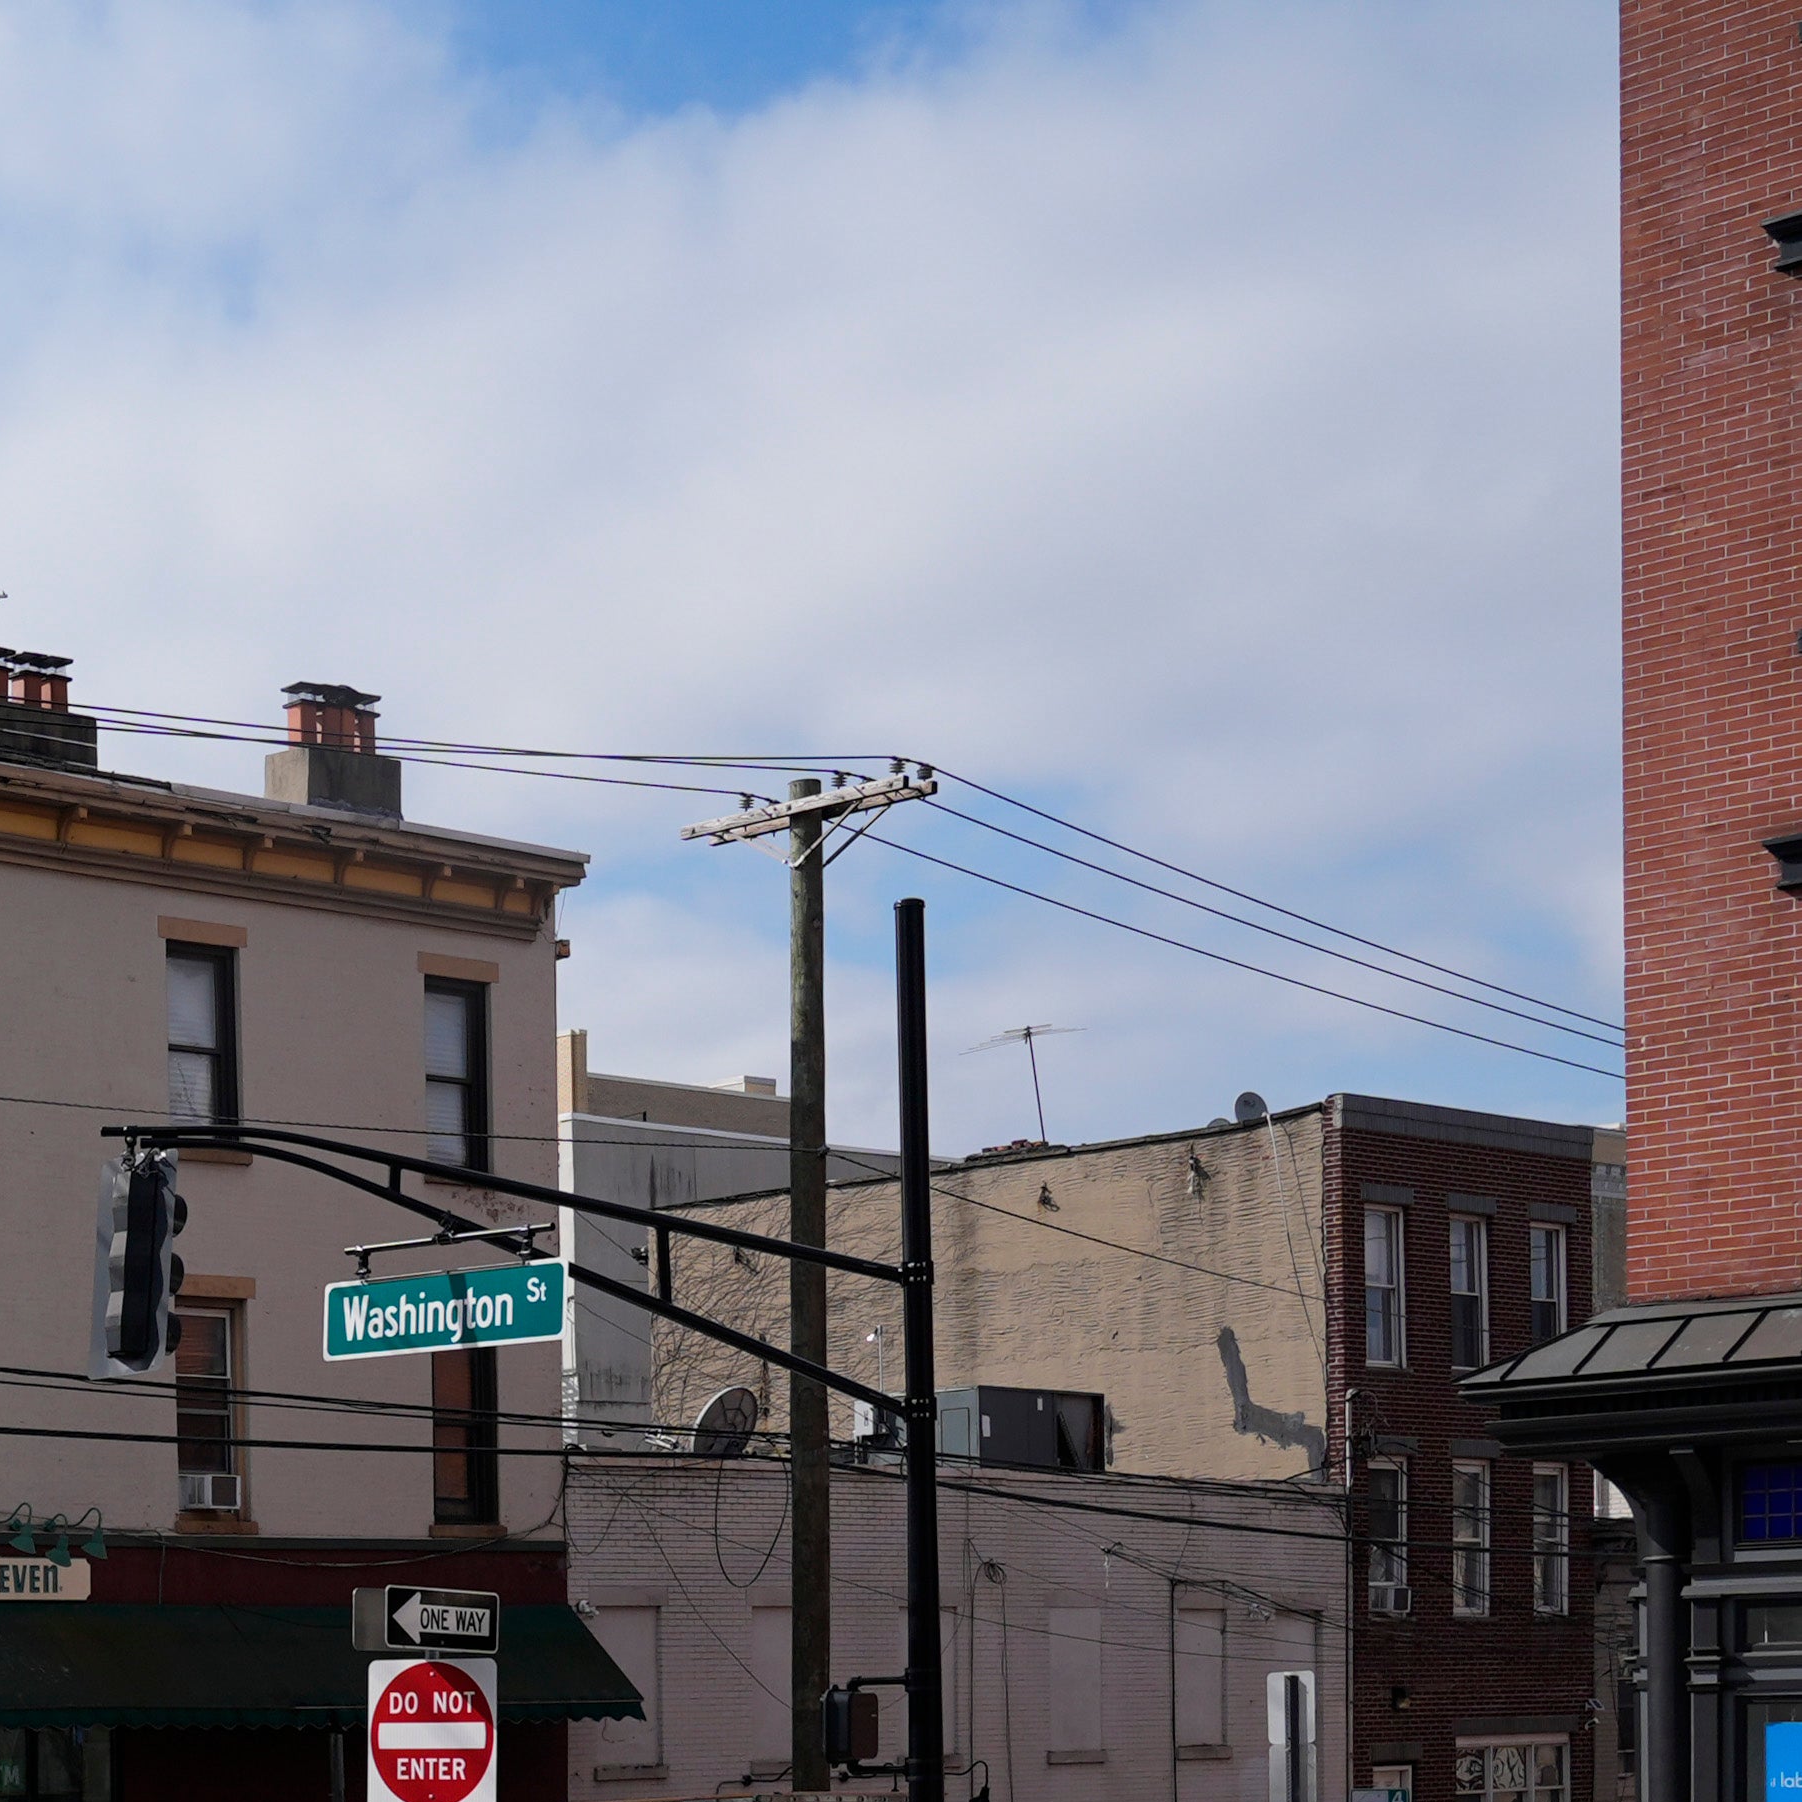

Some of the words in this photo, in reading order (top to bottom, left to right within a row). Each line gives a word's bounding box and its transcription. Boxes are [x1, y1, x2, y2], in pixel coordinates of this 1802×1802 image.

[343, 1286, 513, 1343] Washington
[526, 1277, 547, 1303] St
[419, 1607, 450, 1632] ONE
[455, 1610, 486, 1634] WAY
[389, 1692, 419, 1715] DO
[432, 1691, 476, 1714] NOT
[396, 1757, 467, 1782] ENTER
